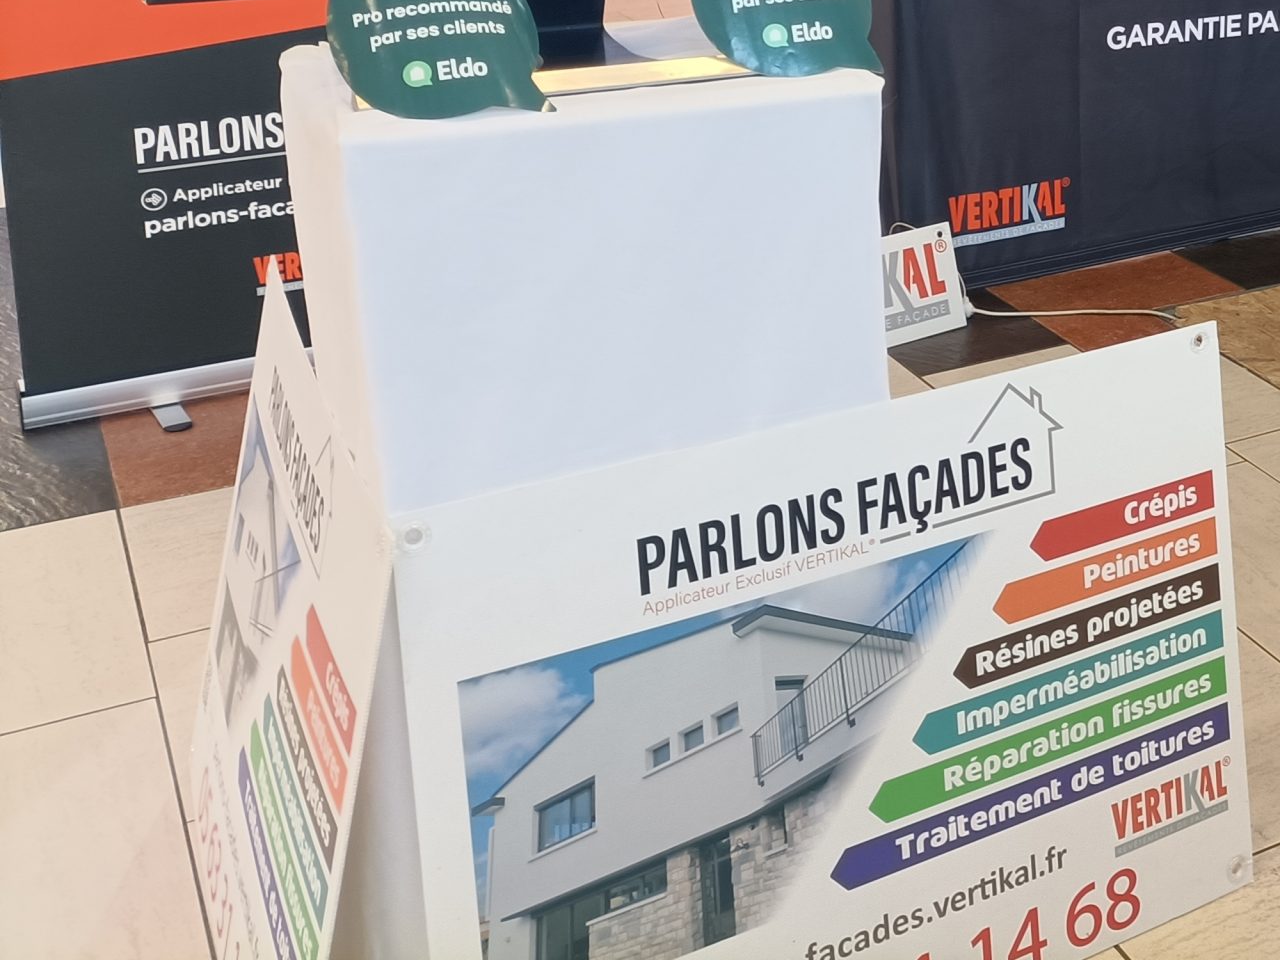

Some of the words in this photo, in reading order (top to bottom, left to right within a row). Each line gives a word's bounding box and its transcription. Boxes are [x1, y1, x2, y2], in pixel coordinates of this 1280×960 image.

[352, 10, 383, 28] Pro
[370, 31, 404, 52] par
[406, 25, 440, 41] ses
[443, 18, 505, 38] clients
[791, 24, 833, 44] Eldo
[1106, 14, 1242, 50] GARANTIE
[437, 58, 488, 83] Eldo
[133, 112, 285, 165] PARLONS
[172, 177, 282, 203] Applicateur
[637, 487, 846, 596] PARLONS
[857, 437, 1033, 534] FAÇADES
[1124, 485, 1198, 525] Crépis
[1083, 533, 1201, 589] Peintures
[643, 580, 731, 616] Applicateur
[735, 561, 792, 591] Exclusif
[975, 623, 1079, 677] Résines
[1087, 580, 1204, 644] projetées
[956, 628, 1207, 736] Imperméabilisation
[943, 716, 1105, 792] Réparation
[1112, 673, 1212, 729] fissures
[896, 778, 1063, 862] Traitement
[1071, 762, 1105, 793] de
[1112, 718, 1215, 778] toitures
[970, 907, 1048, 960] 14
[1065, 868, 1141, 948] 68
